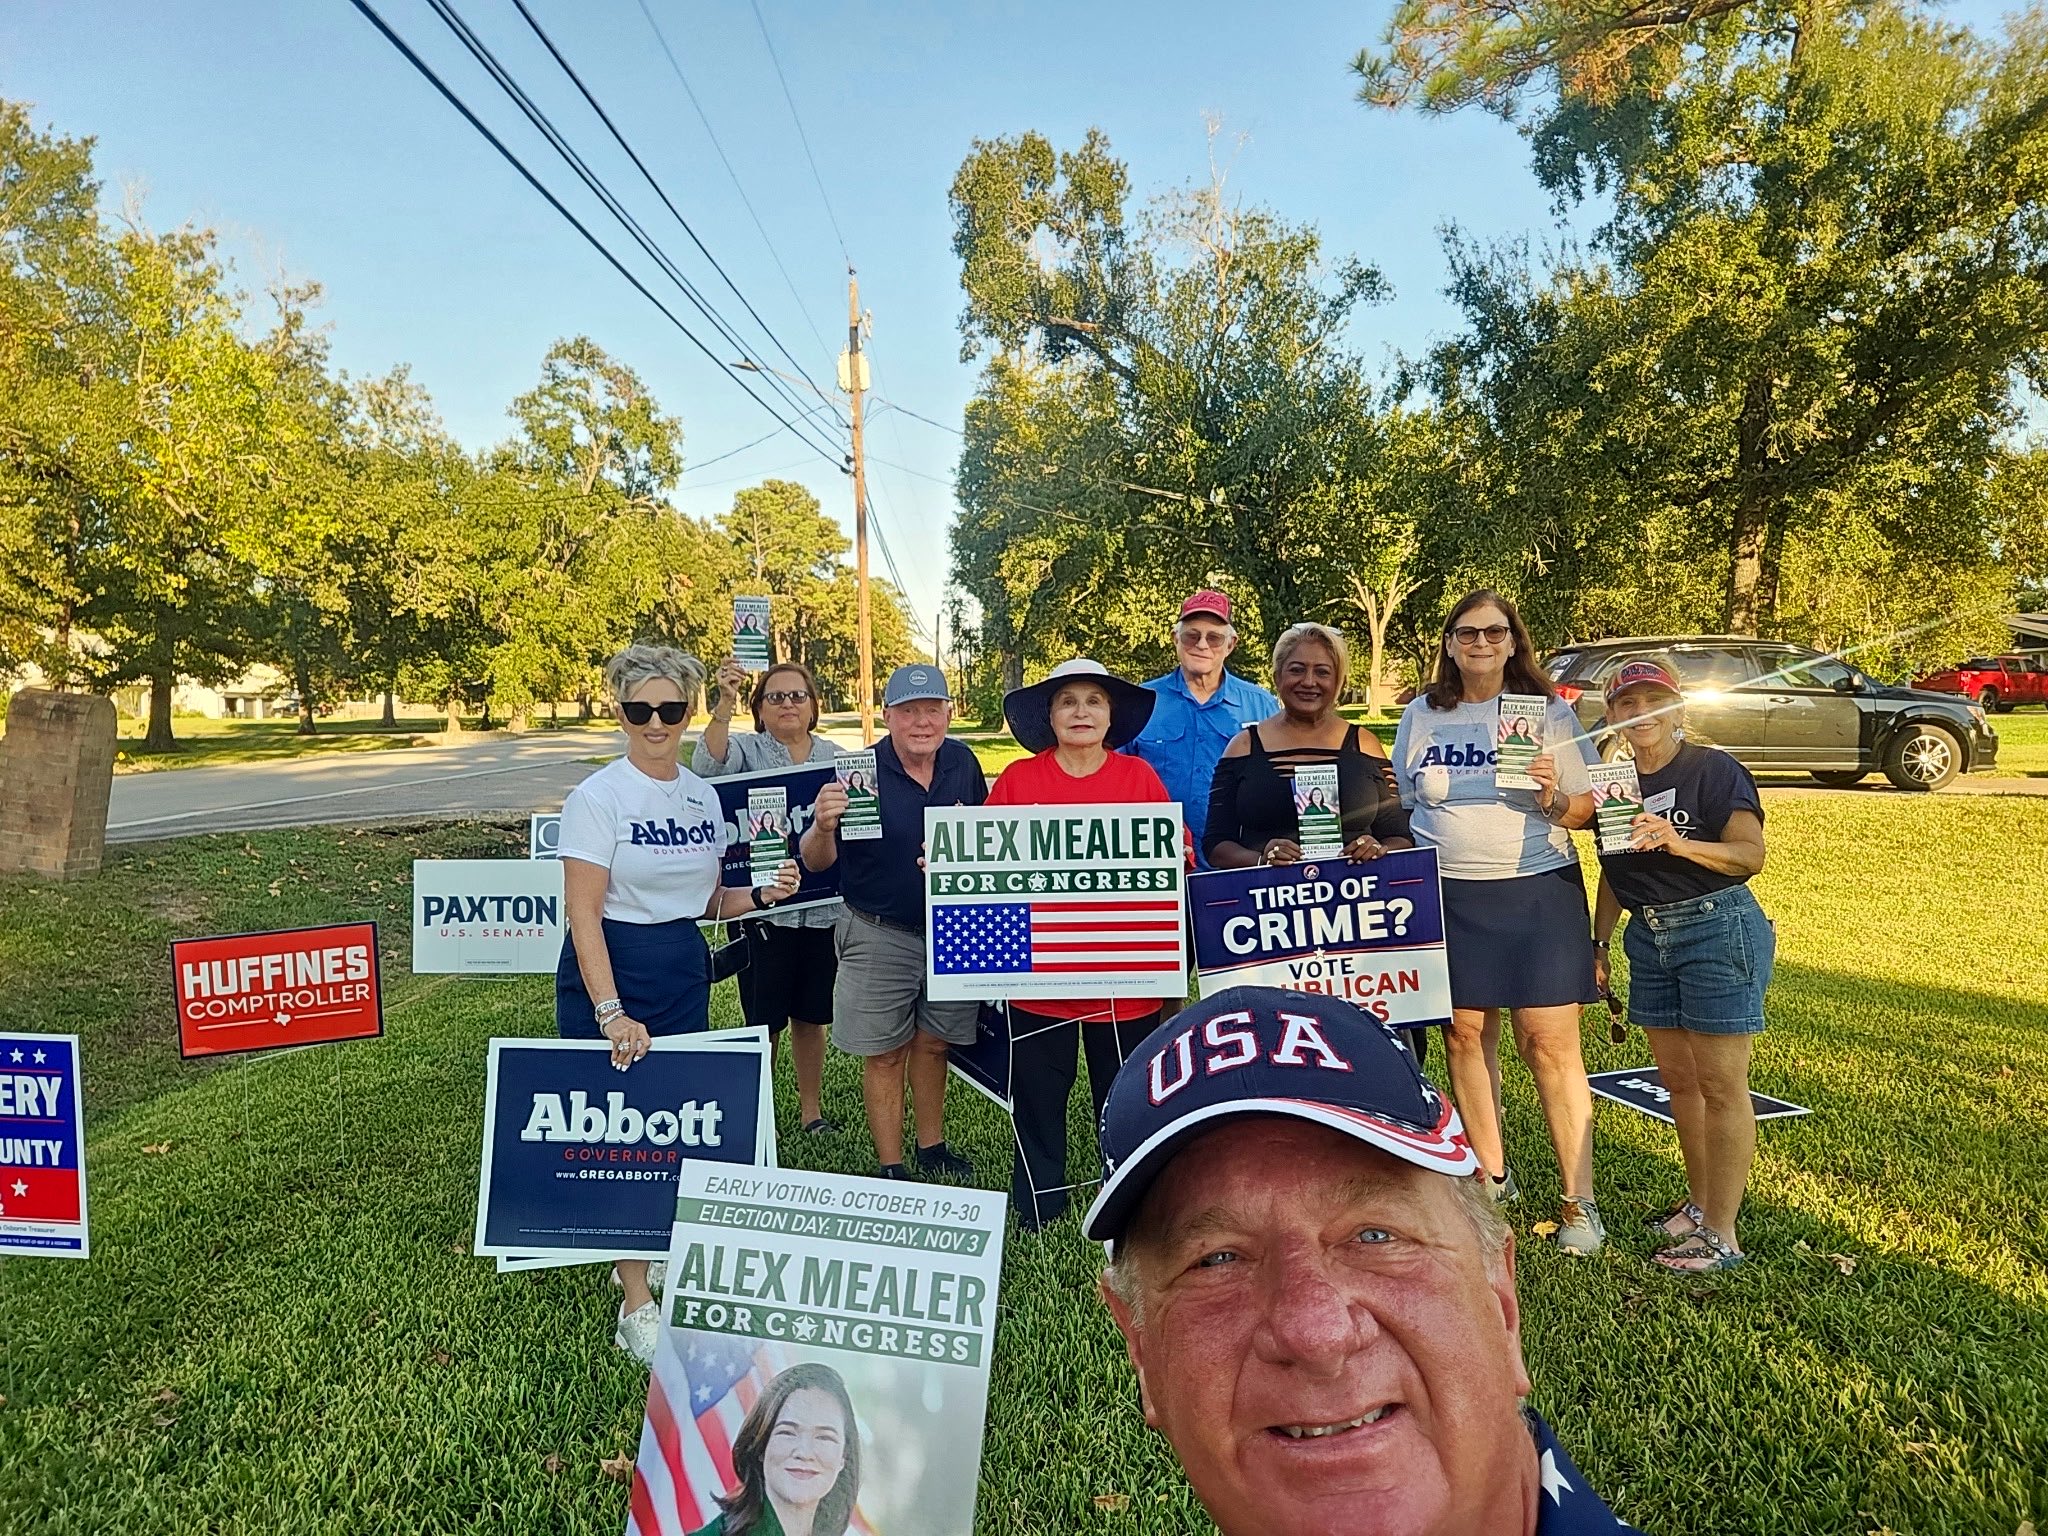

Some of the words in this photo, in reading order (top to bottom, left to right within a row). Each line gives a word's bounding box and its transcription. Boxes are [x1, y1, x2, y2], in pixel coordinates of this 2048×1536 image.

[1519, 704, 1545, 712] MEALER
[1419, 743, 1498, 769] Abbo
[1608, 769, 1635, 777] MEALER
[764, 796, 785, 804] MEALER
[629, 818, 716, 846] Abbott
[930, 820, 1021, 863] ALEX
[1029, 817, 1176, 861] MEALER
[653, 845, 711, 855] GOVERNOR
[938, 874, 997, 892] FOR
[1006, 871, 1169, 892] CONGRESS
[1249, 881, 1334, 910] TIRED
[1340, 875, 1379, 899] OF
[422, 895, 557, 927] PAXTON
[1223, 898, 1414, 955] CRIME?
[440, 928, 473, 938] U.S.
[482, 928, 545, 938] SENATE
[182, 945, 369, 1000] HUFFINES
[1289, 957, 1356, 980] VOTE
[186, 983, 370, 1019] COMPTROLLER
[1147, 1008, 1354, 1106] USA
[0, 1075, 62, 1117] ERY
[521, 1091, 723, 1146] Abbott
[0, 1138, 63, 1166] UNTY
[564, 1148, 678, 1163] GOVERNOR
[555, 1169, 680, 1181] www.GREGABBOTT.co
[704, 1176, 763, 1198] EARLY
[767, 1183, 836, 1206] VOTING:
[841, 1191, 926, 1216] OCTOBER
[932, 1200, 981, 1222] 19-30
[699, 1204, 788, 1229] ELECTION
[791, 1215, 831, 1235] DAY:
[836, 1218, 918, 1247] TUESDAY,
[924, 1230, 967, 1251] NOV
[967, 1235, 980, 1253] 3
[676, 1242, 792, 1302] ALEX
[799, 1256, 986, 1328] MEALER
[683, 1301, 752, 1332] FOR
[766, 1313, 970, 1360] CONGRESS
